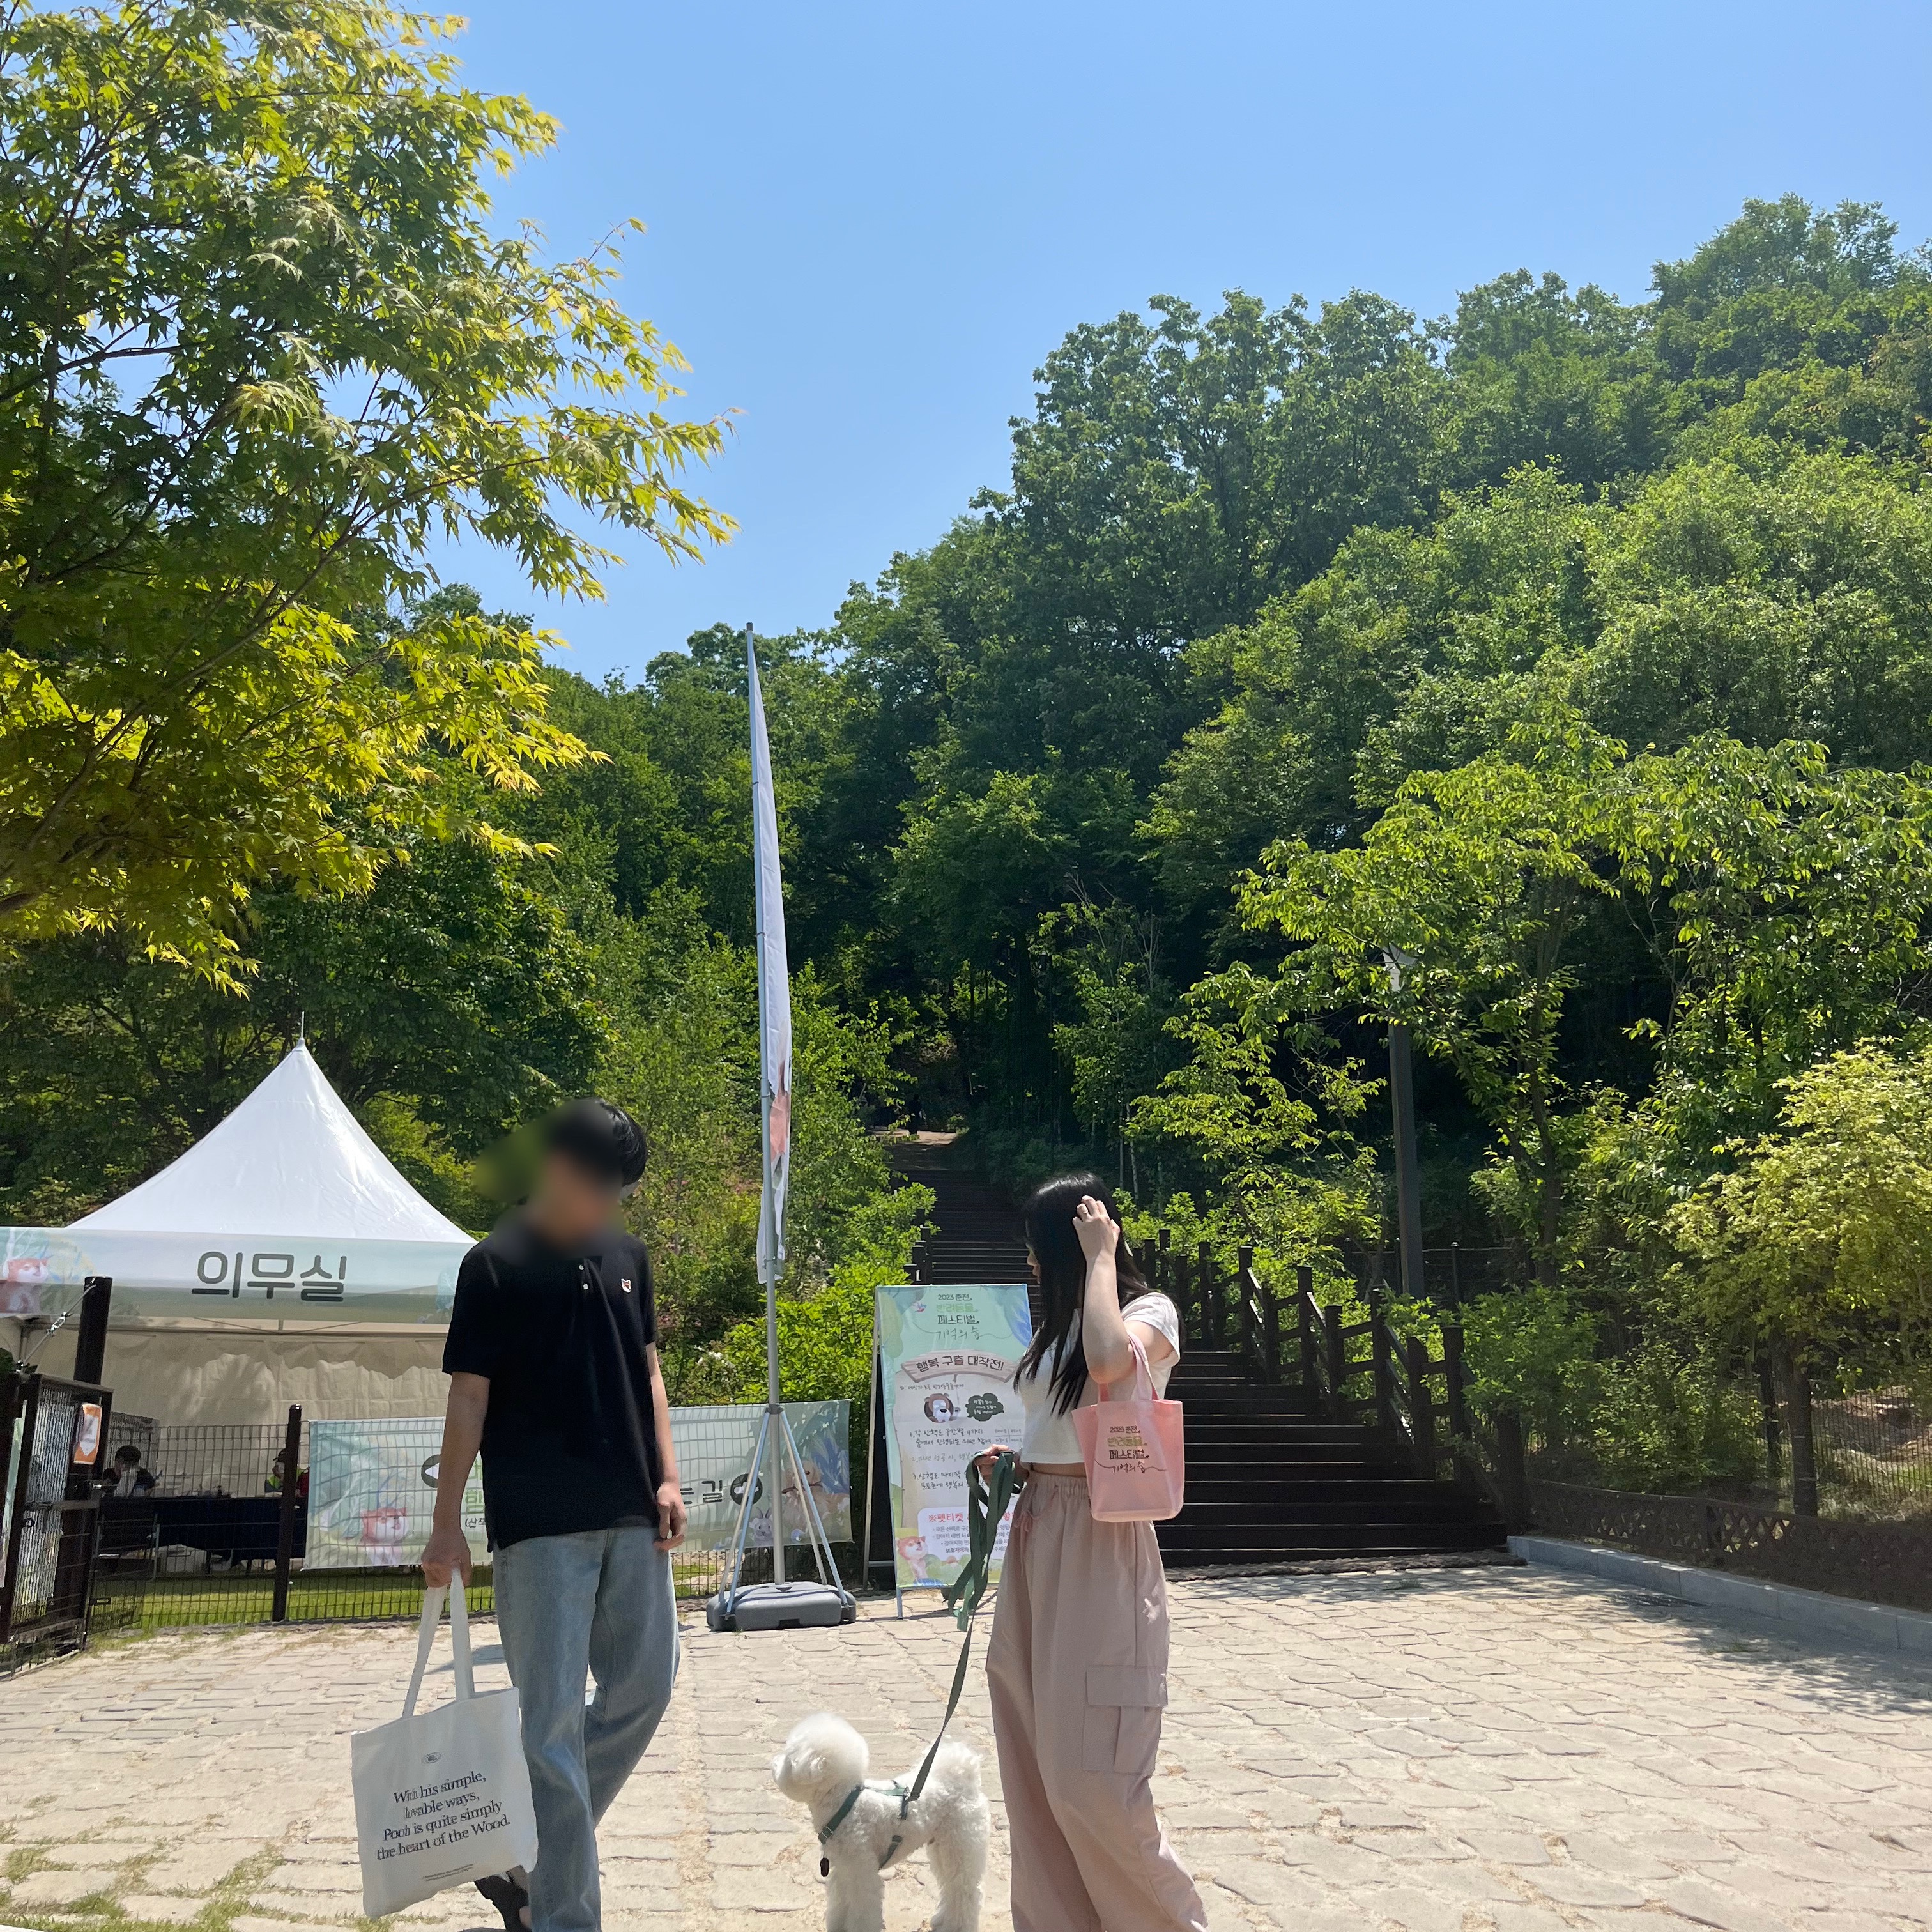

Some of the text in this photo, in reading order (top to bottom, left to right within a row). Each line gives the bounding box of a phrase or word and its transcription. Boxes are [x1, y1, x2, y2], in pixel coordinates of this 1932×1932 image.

[192, 1250, 347, 1303] 의무실
[937, 1326, 980, 1340] 기억의 숲
[916, 1355, 1004, 1372] 행복 구출 대작전!
[923, 1429, 943, 1437] 산책로
[946, 1427, 964, 1437] 구간별
[916, 1439, 934, 1449] 숲에서
[936, 1438, 960, 1446] 진행되는
[934, 1453, 946, 1462] 성공
[1112, 1460, 1146, 1473] 기억의 숲
[941, 1470, 962, 1480] 마지막
[702, 1480, 723, 1503] 길
[921, 1480, 964, 1491] 포토존에 행복의
[393, 1771, 486, 1804] With his simple,
[404, 1791, 480, 1820] lovable ways,
[383, 1800, 503, 1841] Pooh is quite simply
[377, 1814, 511, 1860] the heart of the Wood.
